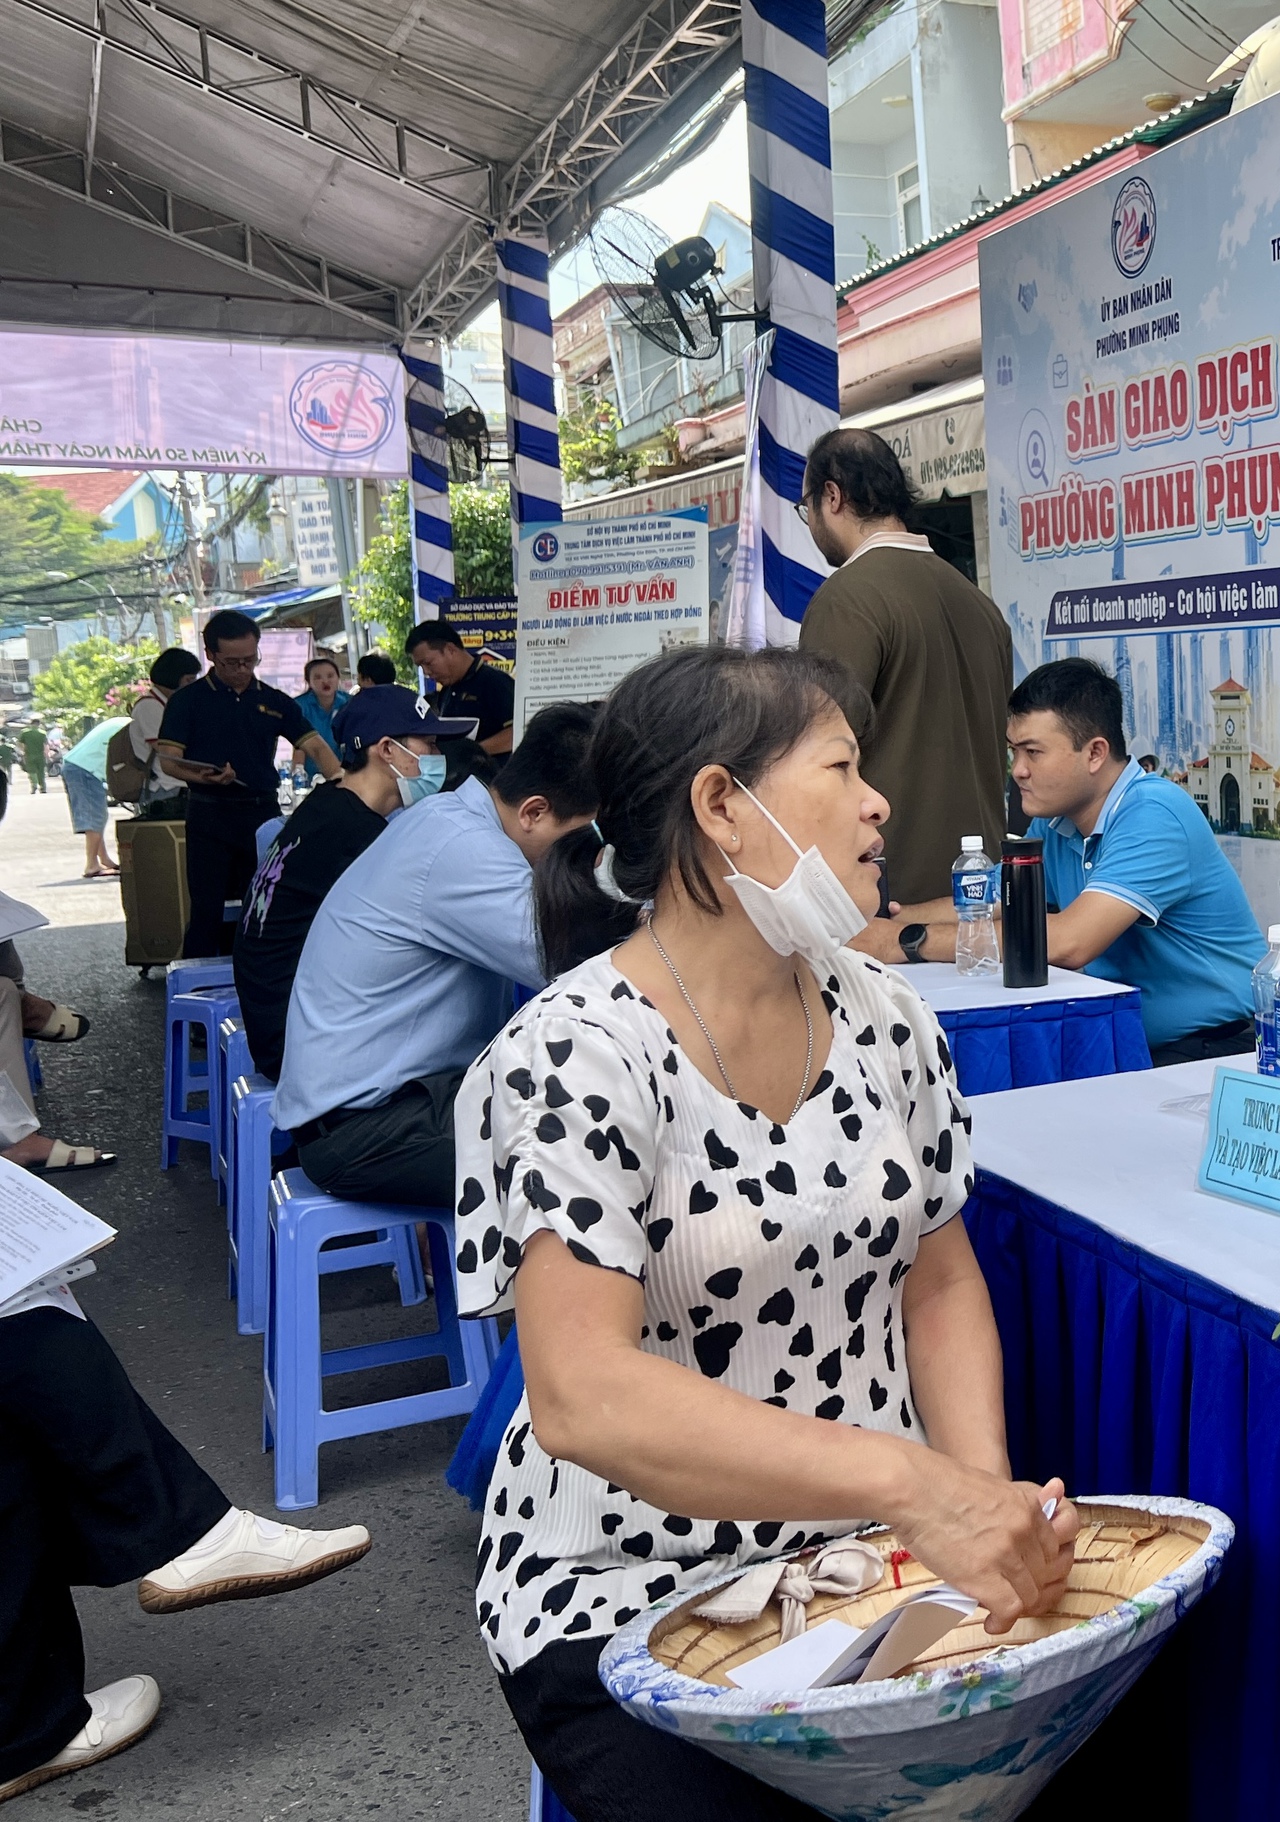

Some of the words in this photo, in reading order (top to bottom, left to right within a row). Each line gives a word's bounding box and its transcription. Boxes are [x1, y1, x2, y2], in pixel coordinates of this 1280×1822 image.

[1101, 297, 1111, 322] ỦY
[1113, 294, 1129, 319] BAN
[1131, 283, 1153, 312] NHÂN
[1155, 277, 1172, 304] DÂN
[1097, 331, 1127, 358] PHƯỜNG
[1129, 322, 1149, 348] MINH
[1152, 313, 1179, 341] PHỤNG
[1066, 384, 1116, 453] SÀN
[1124, 369, 1188, 439] GIAO
[1198, 344, 1273, 432] DỊCH
[1021, 479, 1115, 551] PHƯỜNG
[1124, 469, 1196, 535] MINH
[549, 579, 599, 610] ĐIỂM
[605, 583, 631, 606] TƯ
[636, 574, 675, 604] VẤN
[1055, 595, 1072, 625] Kết
[1074, 595, 1090, 623] nối
[1092, 596, 1125, 622] doanh
[1127, 591, 1166, 623] nghiệp
[1177, 589, 1194, 615] Cơ
[1196, 585, 1216, 619] hội
[1219, 583, 1248, 617] việc
[1252, 581, 1278, 610] làm
[1243, 1098, 1278, 1132] TRUNG
